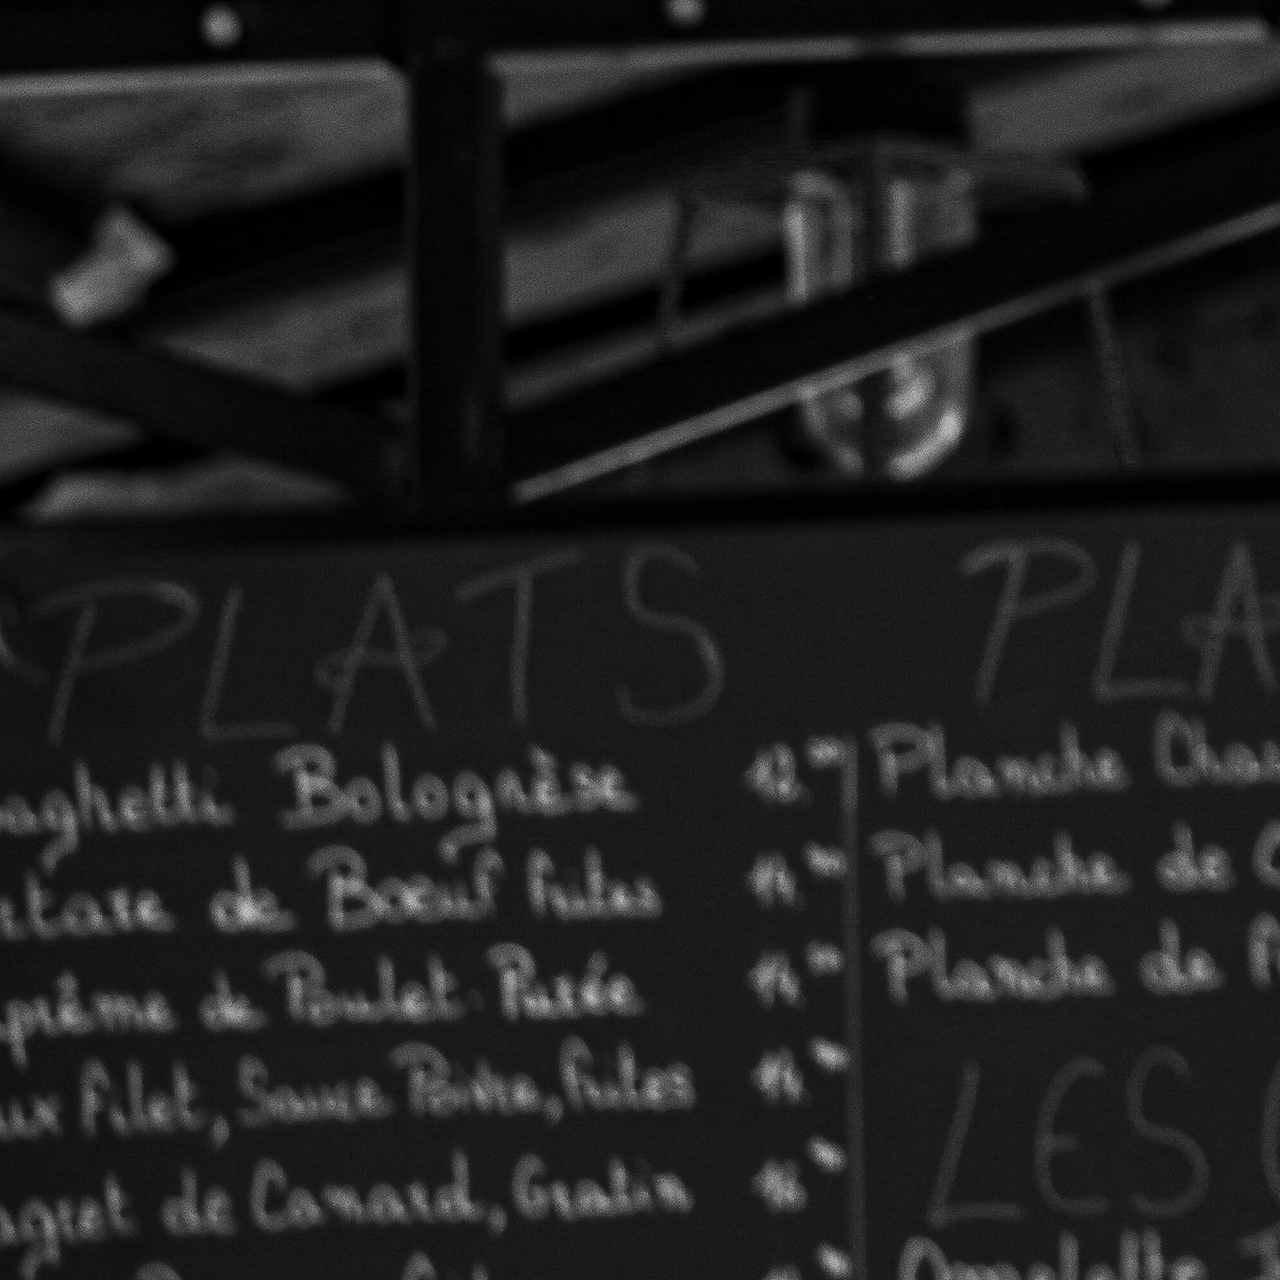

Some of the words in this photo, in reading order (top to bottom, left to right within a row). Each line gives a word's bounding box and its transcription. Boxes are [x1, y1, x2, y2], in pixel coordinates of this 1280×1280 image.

[1154, 818, 1237, 894] de
[1138, 916, 1226, 994] de
[925, 1044, 1211, 1230] LES
